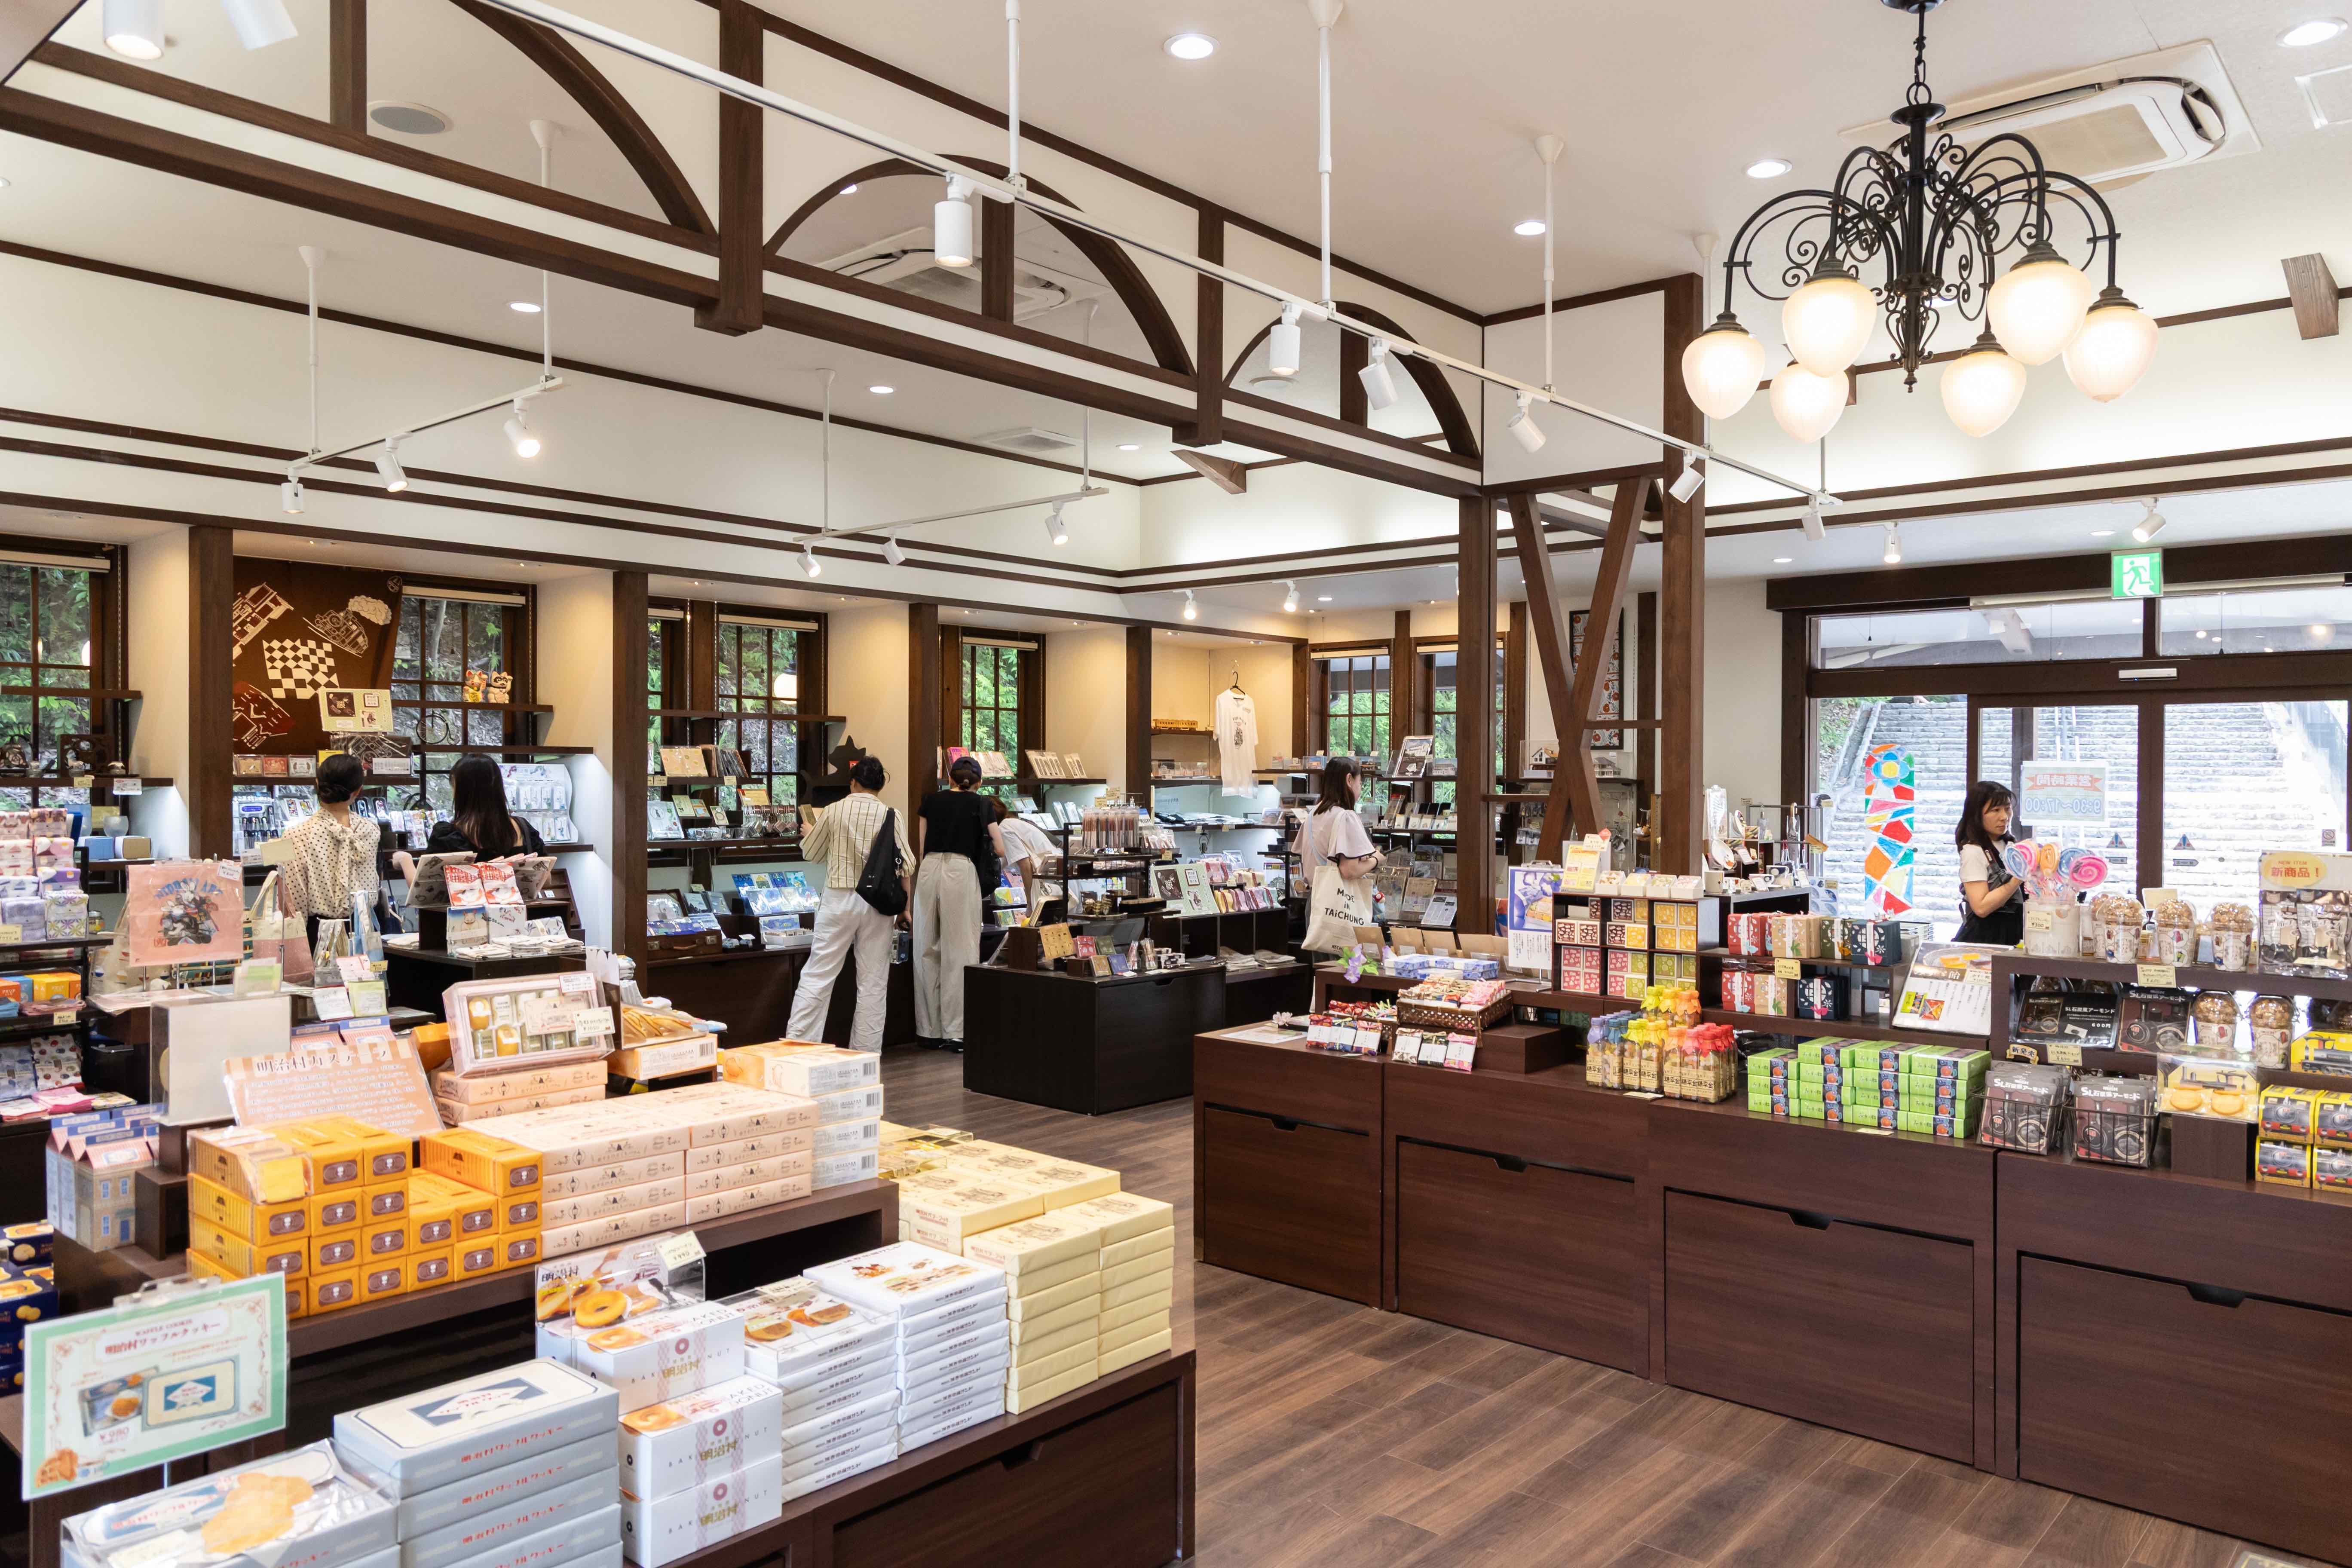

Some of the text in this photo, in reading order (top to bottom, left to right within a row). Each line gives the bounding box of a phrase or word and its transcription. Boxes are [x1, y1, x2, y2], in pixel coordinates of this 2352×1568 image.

[1337, 888, 1354, 903] MDE
[2012, 1046, 2035, 1058] 新発売
[662, 1359, 701, 1378] 明治村
[699, 1441, 738, 1461] 明治村
[700, 1505, 738, 1527] 明治村
